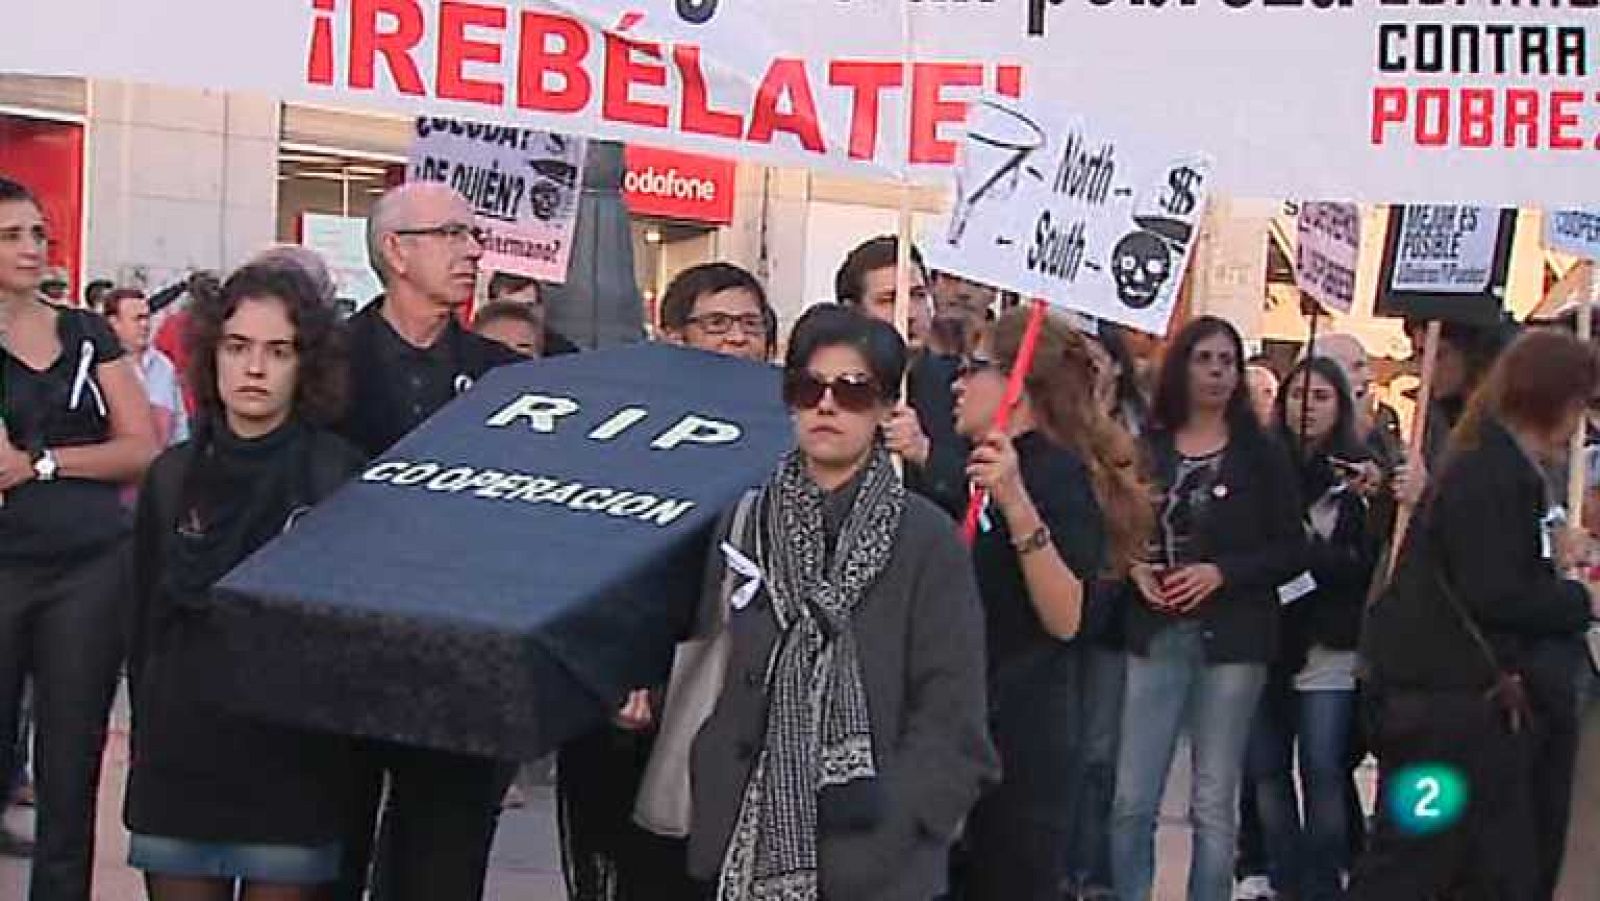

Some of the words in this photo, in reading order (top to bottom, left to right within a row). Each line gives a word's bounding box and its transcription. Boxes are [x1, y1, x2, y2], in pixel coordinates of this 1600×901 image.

[1378, 24, 1586, 76] CONTRA
[1052, 131, 1114, 204] North
[1027, 210, 1085, 283] South
[362, 462, 695, 526] COOPERACION
